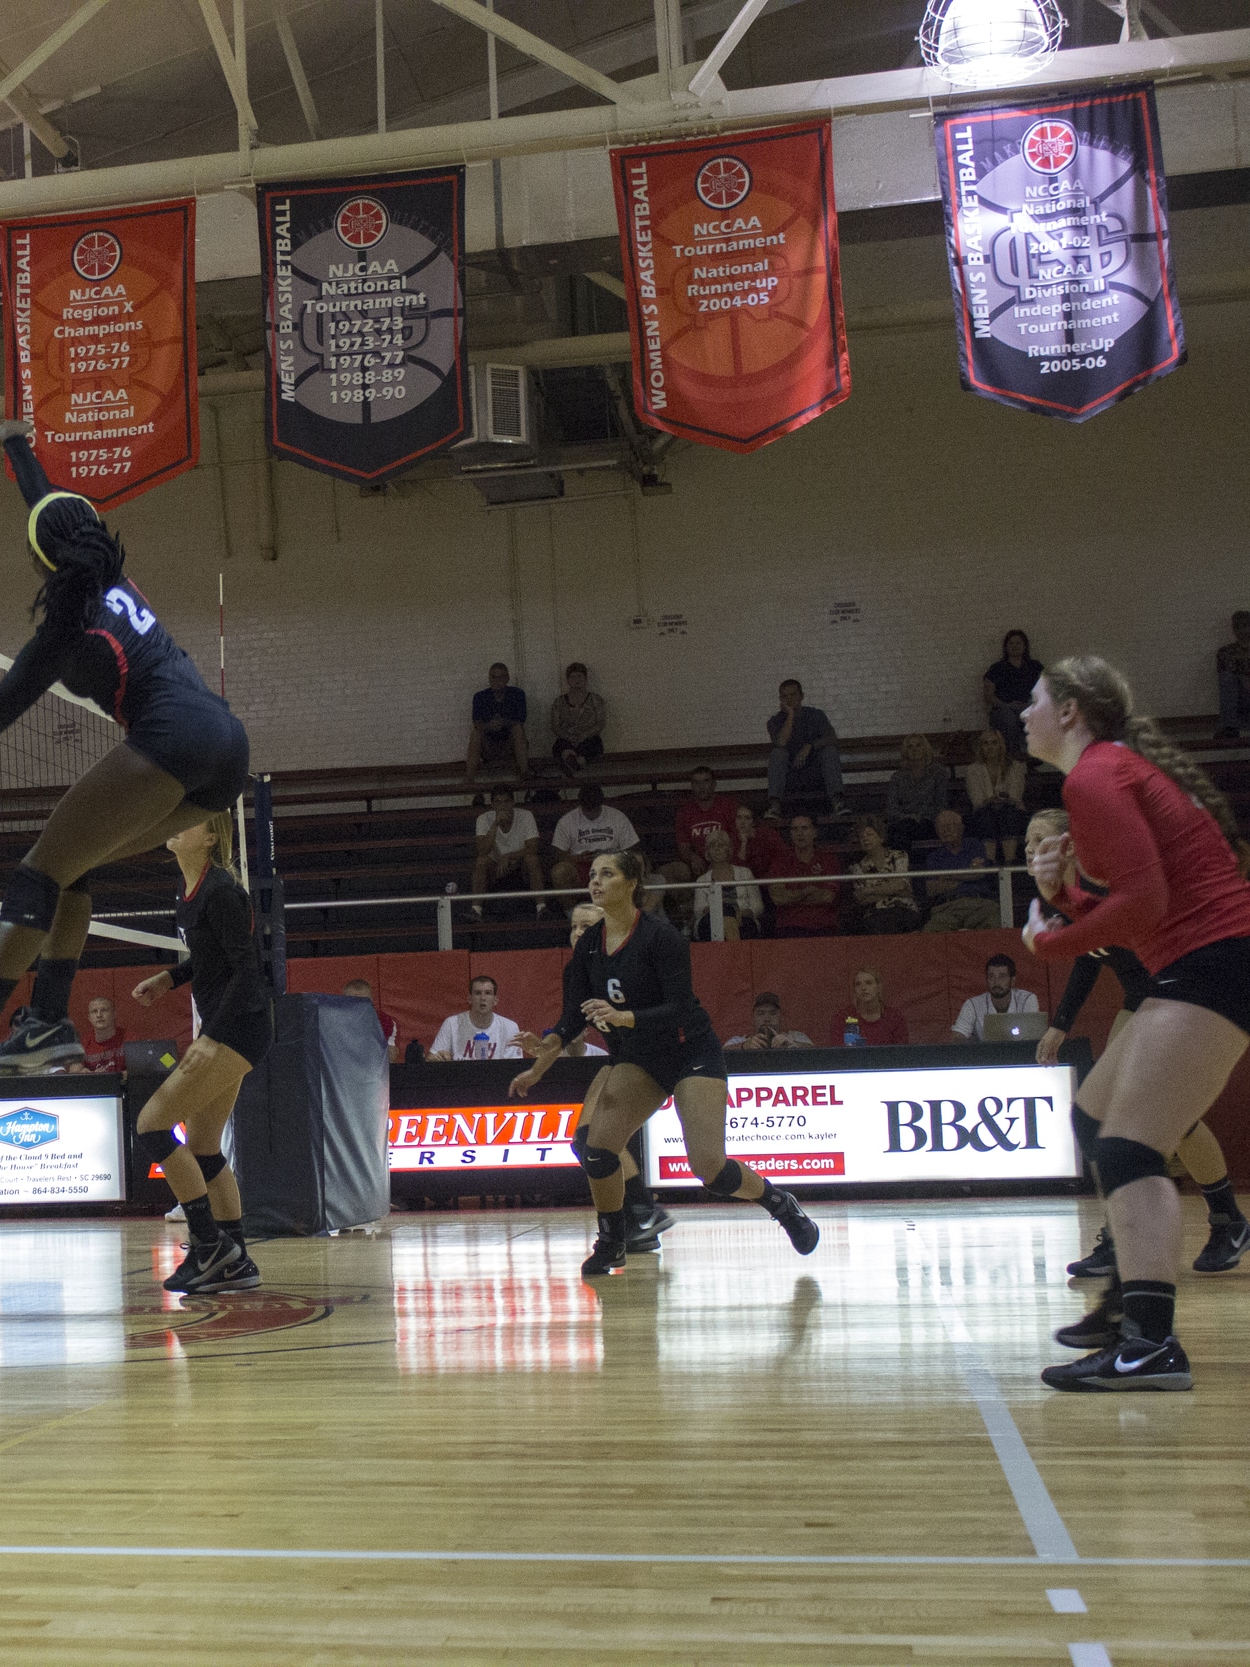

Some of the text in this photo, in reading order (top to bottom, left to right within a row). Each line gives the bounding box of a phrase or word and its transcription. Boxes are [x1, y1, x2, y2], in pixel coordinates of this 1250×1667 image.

[1025, 179, 1084, 198] NCCAA
[1021, 196, 1090, 216] National
[693, 215, 762, 236] NCCAA
[954, 126, 991, 338] MEN'S BASKETBALL
[1009, 211, 1108, 234] Tournament
[672, 232, 786, 258] Tournament
[328, 259, 399, 278] NJCAA
[693, 259, 769, 280] National
[1038, 264, 1087, 281] NCAA
[69, 284, 126, 301] NJCAA
[321, 276, 407, 296] National
[631, 161, 667, 410] WOMEN'S BASKETBALL
[687, 276, 778, 297] Runner-up
[1024, 278, 1105, 300] Division II
[275, 199, 295, 402] MEN'S BASKETBALL
[303, 291, 426, 314] Tournament
[698, 292, 770, 313] 2004-05
[1013, 293, 1120, 318] Independent
[62, 301, 134, 321] Region X
[53, 320, 143, 338] Champions
[328, 316, 404, 335] 1972-73
[1017, 312, 1120, 335] Tournament
[16, 233, 37, 452] OMEN'S BASKETBALL
[69, 341, 130, 358] 1975-76
[328, 334, 405, 352] 1973-74
[1028, 337, 1116, 357] Runner-Up
[69, 357, 130, 374] 1976-77
[329, 351, 405, 369] 1976-77
[1040, 356, 1107, 374] 2005-06
[330, 368, 406, 386] 1988-89
[71, 388, 128, 405] NJCAA
[330, 385, 406, 404] 1989-90
[65, 406, 134, 424] National
[70, 446, 132, 462] 1975-76
[71, 462, 132, 478] 1976-77
[105, 586, 156, 636] 2
[607, 978, 626, 1004] 6
[0, 1120, 55, 1137] Hampton
[725, 1115, 807, 1129] -674-5770
[880, 1096, 1054, 1153] BB&T
[12, 1132, 41, 1144] Inn
[5, 1154, 18, 1162] the
[19, 1153, 42, 1161] Cloud
[67, 1152, 83, 1160] and
[40, 1162, 78, 1170] Breakfast
[26, 1175, 55, 1183] Travelers
[32, 1186, 89, 1195] 864-834-5550
